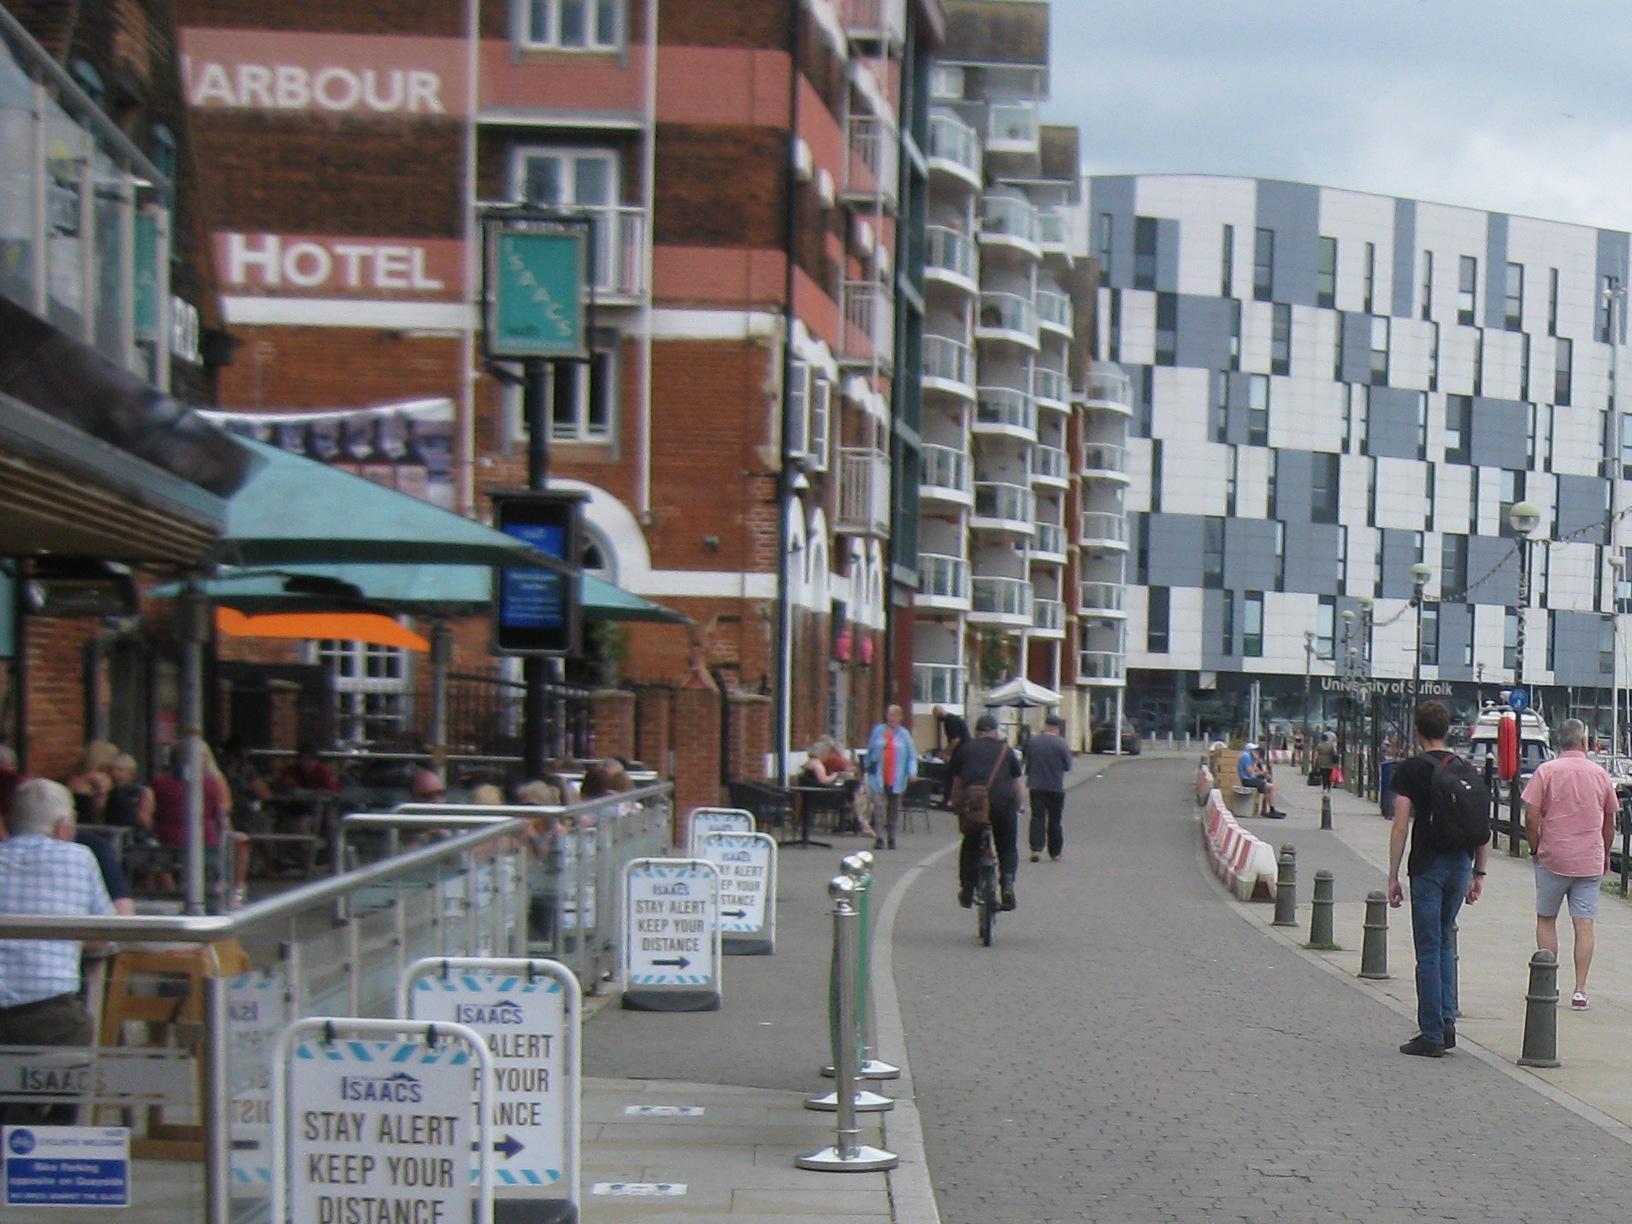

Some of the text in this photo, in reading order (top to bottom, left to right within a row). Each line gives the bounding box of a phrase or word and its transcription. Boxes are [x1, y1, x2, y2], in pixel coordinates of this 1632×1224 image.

[228, 234, 445, 290] HOTEL
[1391, 681, 1405, 694] of
[735, 865, 764, 877] ALERT
[635, 900, 706, 914] STAY ALERT
[637, 919, 704, 933] KEEP YOUR
[641, 937, 700, 952] DISTANCE
[456, 1003, 524, 1024] ISAACS
[489, 1033, 554, 1058] ALERT
[341, 1075, 423, 1103] ISAACS
[495, 1067, 549, 1092] YOUR
[304, 1111, 459, 1145] STAY ALERT
[309, 1153, 454, 1188] KEEP YOUR
